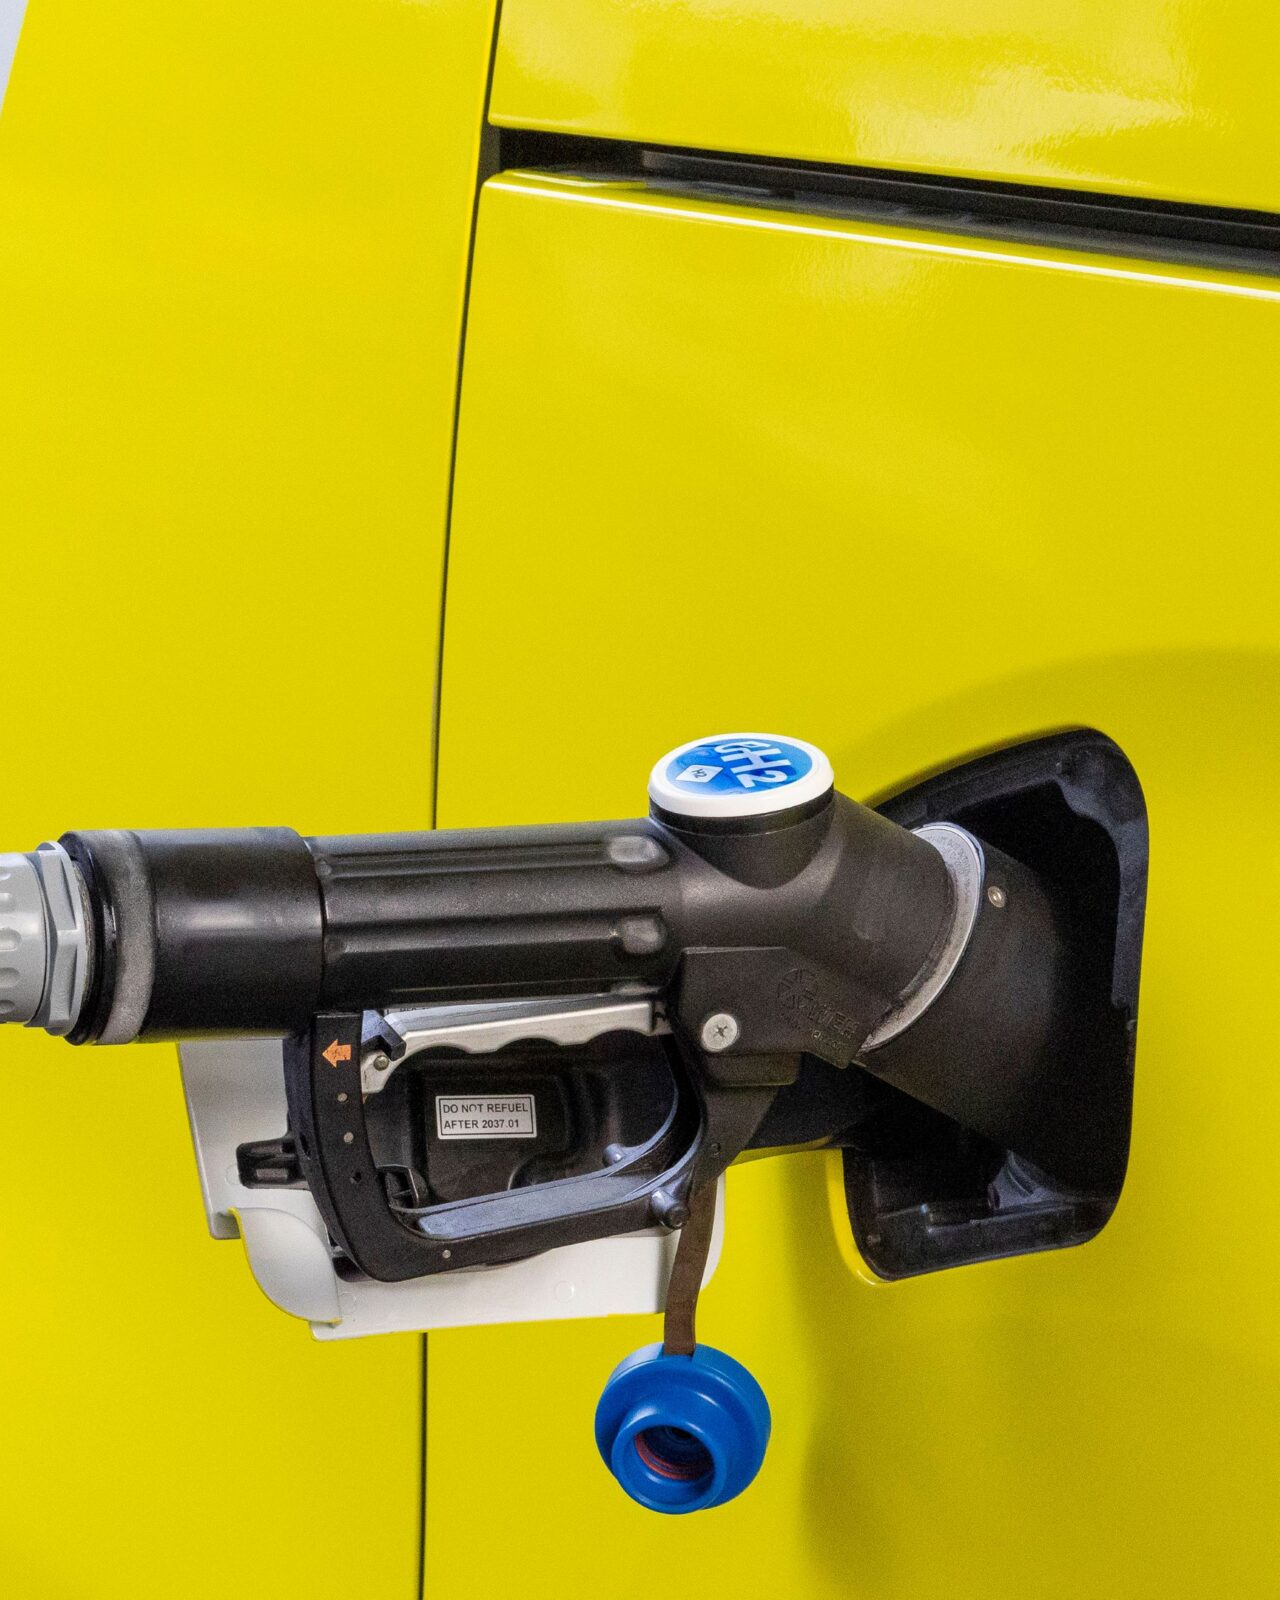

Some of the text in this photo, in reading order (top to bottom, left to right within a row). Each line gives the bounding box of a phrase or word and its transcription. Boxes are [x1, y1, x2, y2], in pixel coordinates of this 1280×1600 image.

[443, 1103, 528, 1113] DO NOT REFUEL
[444, 1119, 519, 1129] AFTER 2037.01
